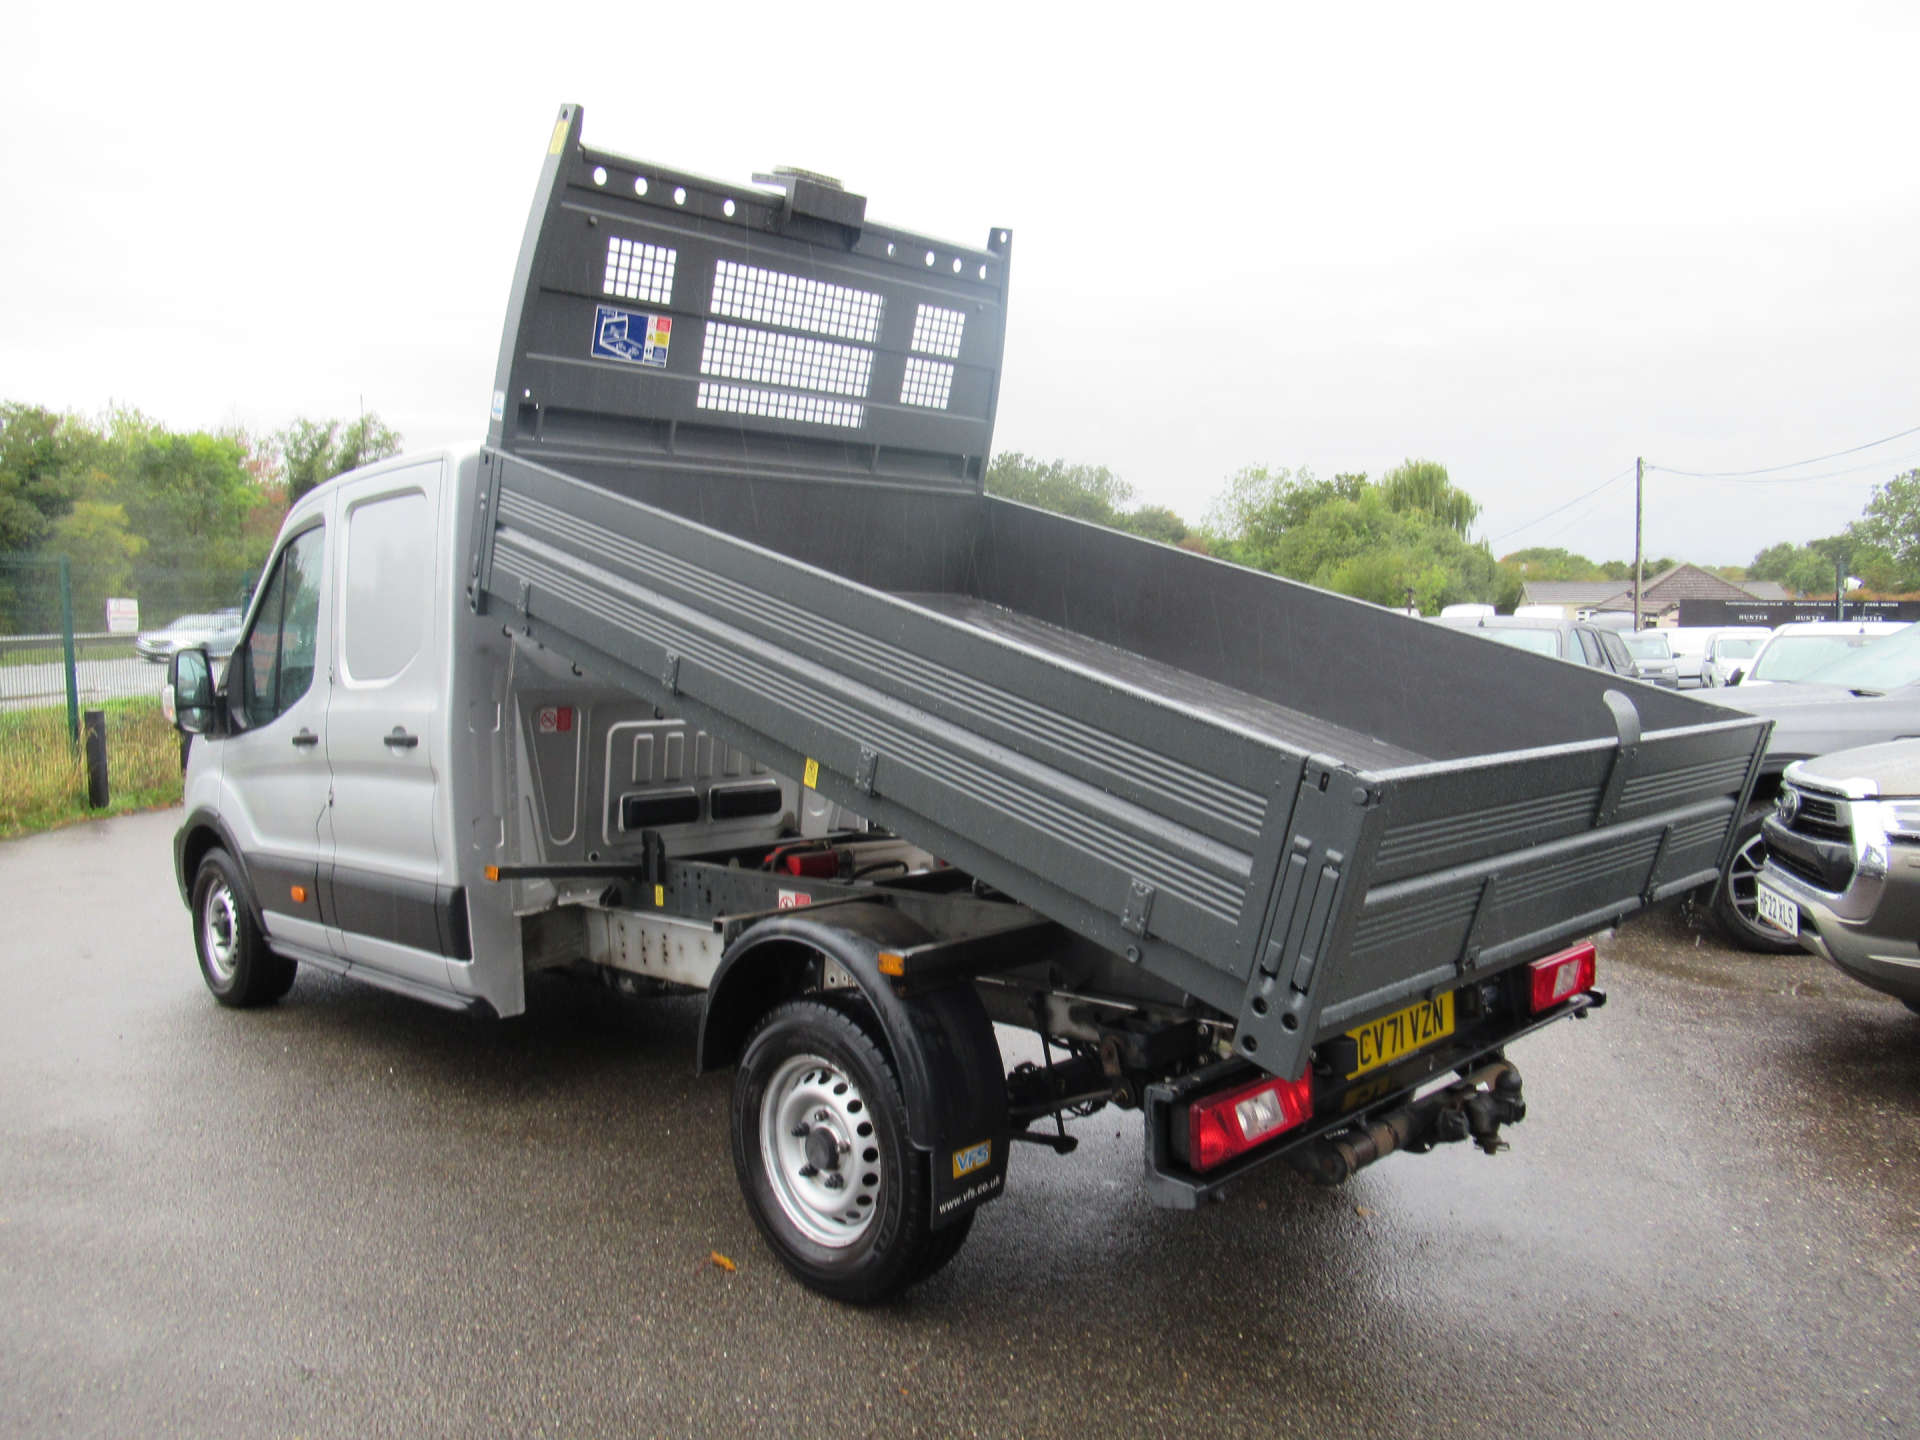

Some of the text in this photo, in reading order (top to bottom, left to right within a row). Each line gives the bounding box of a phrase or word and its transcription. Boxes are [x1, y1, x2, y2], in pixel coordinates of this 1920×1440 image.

[1738, 613, 1768, 621] HUNTER
[1778, 903, 1794, 929] XLS
[1360, 998, 1444, 1065] CV71 VZN
[955, 1143, 989, 1171] VFS
[938, 1175, 1001, 1214] www.vfs.co.uk
